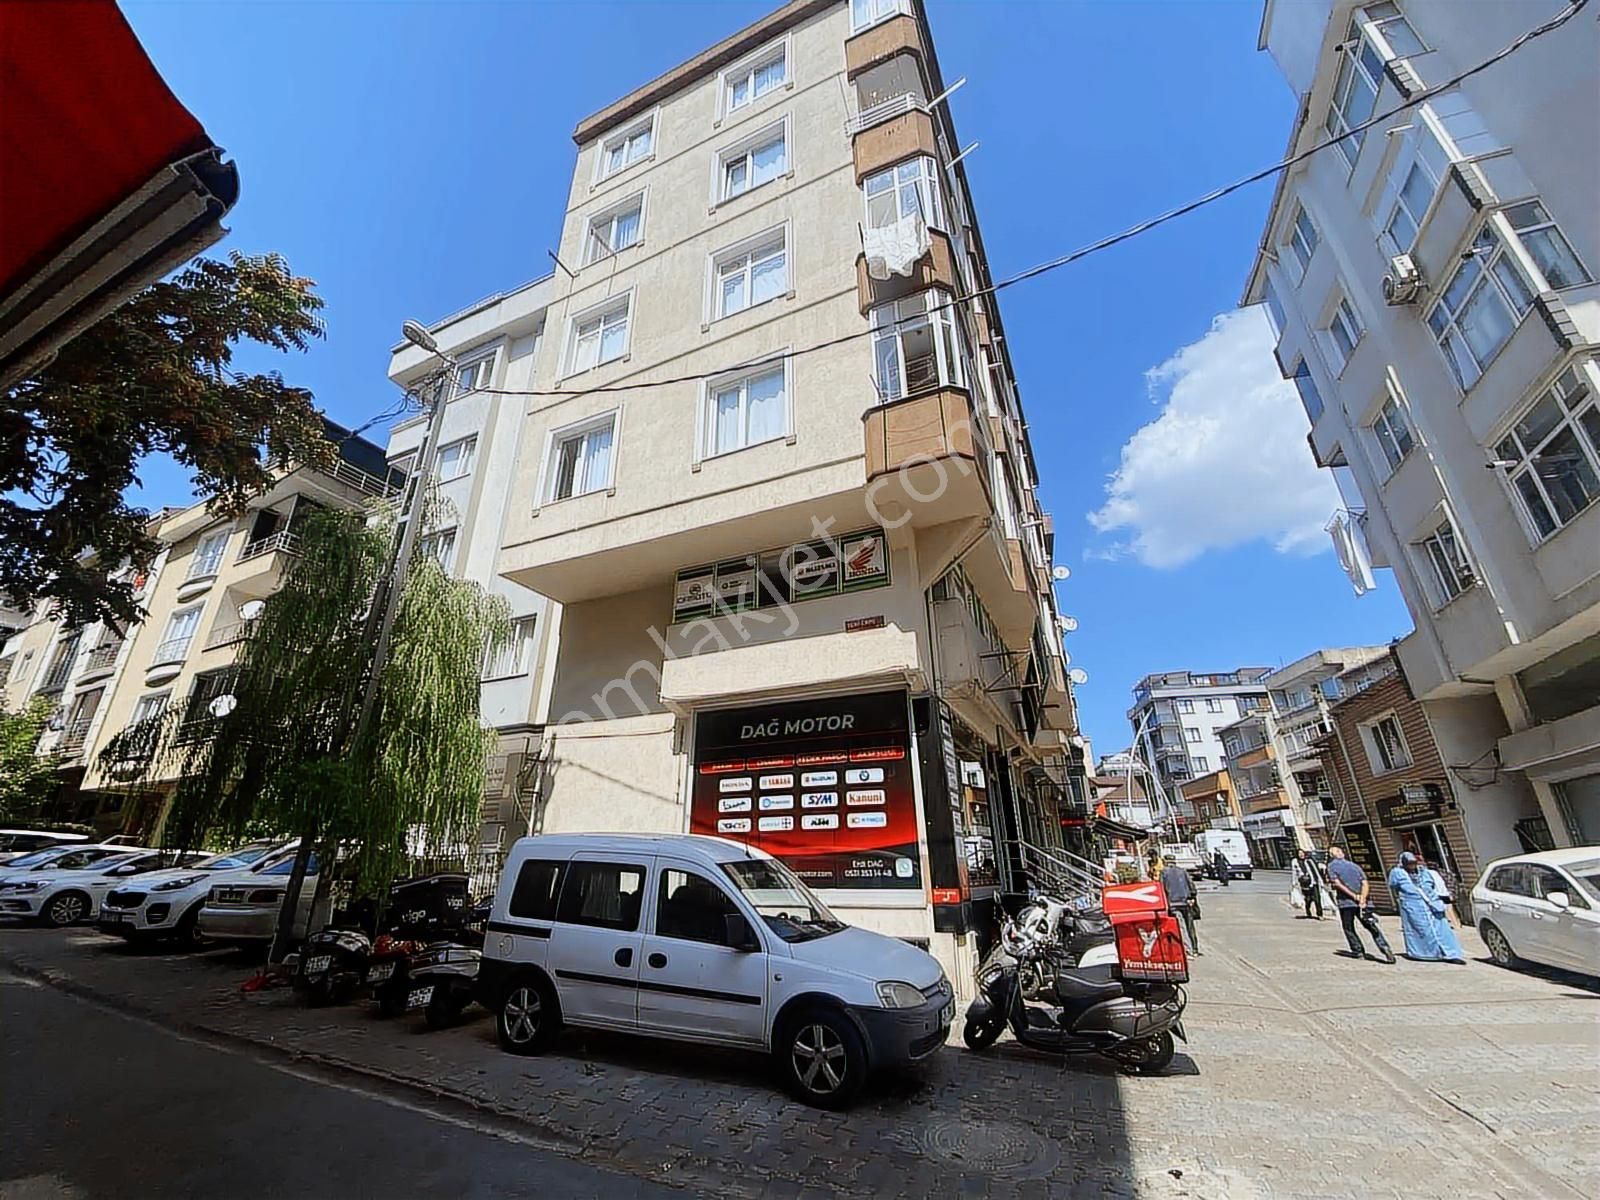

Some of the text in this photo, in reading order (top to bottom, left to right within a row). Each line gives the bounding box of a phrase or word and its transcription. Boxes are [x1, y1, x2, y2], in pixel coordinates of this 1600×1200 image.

[805, 562, 836, 573] SUZUKI
[849, 566, 881, 578] HONDA
[740, 714, 855, 739] DAĞ MOTOR
[808, 794, 832, 805] SYM
[849, 792, 882, 803] Kanuni
